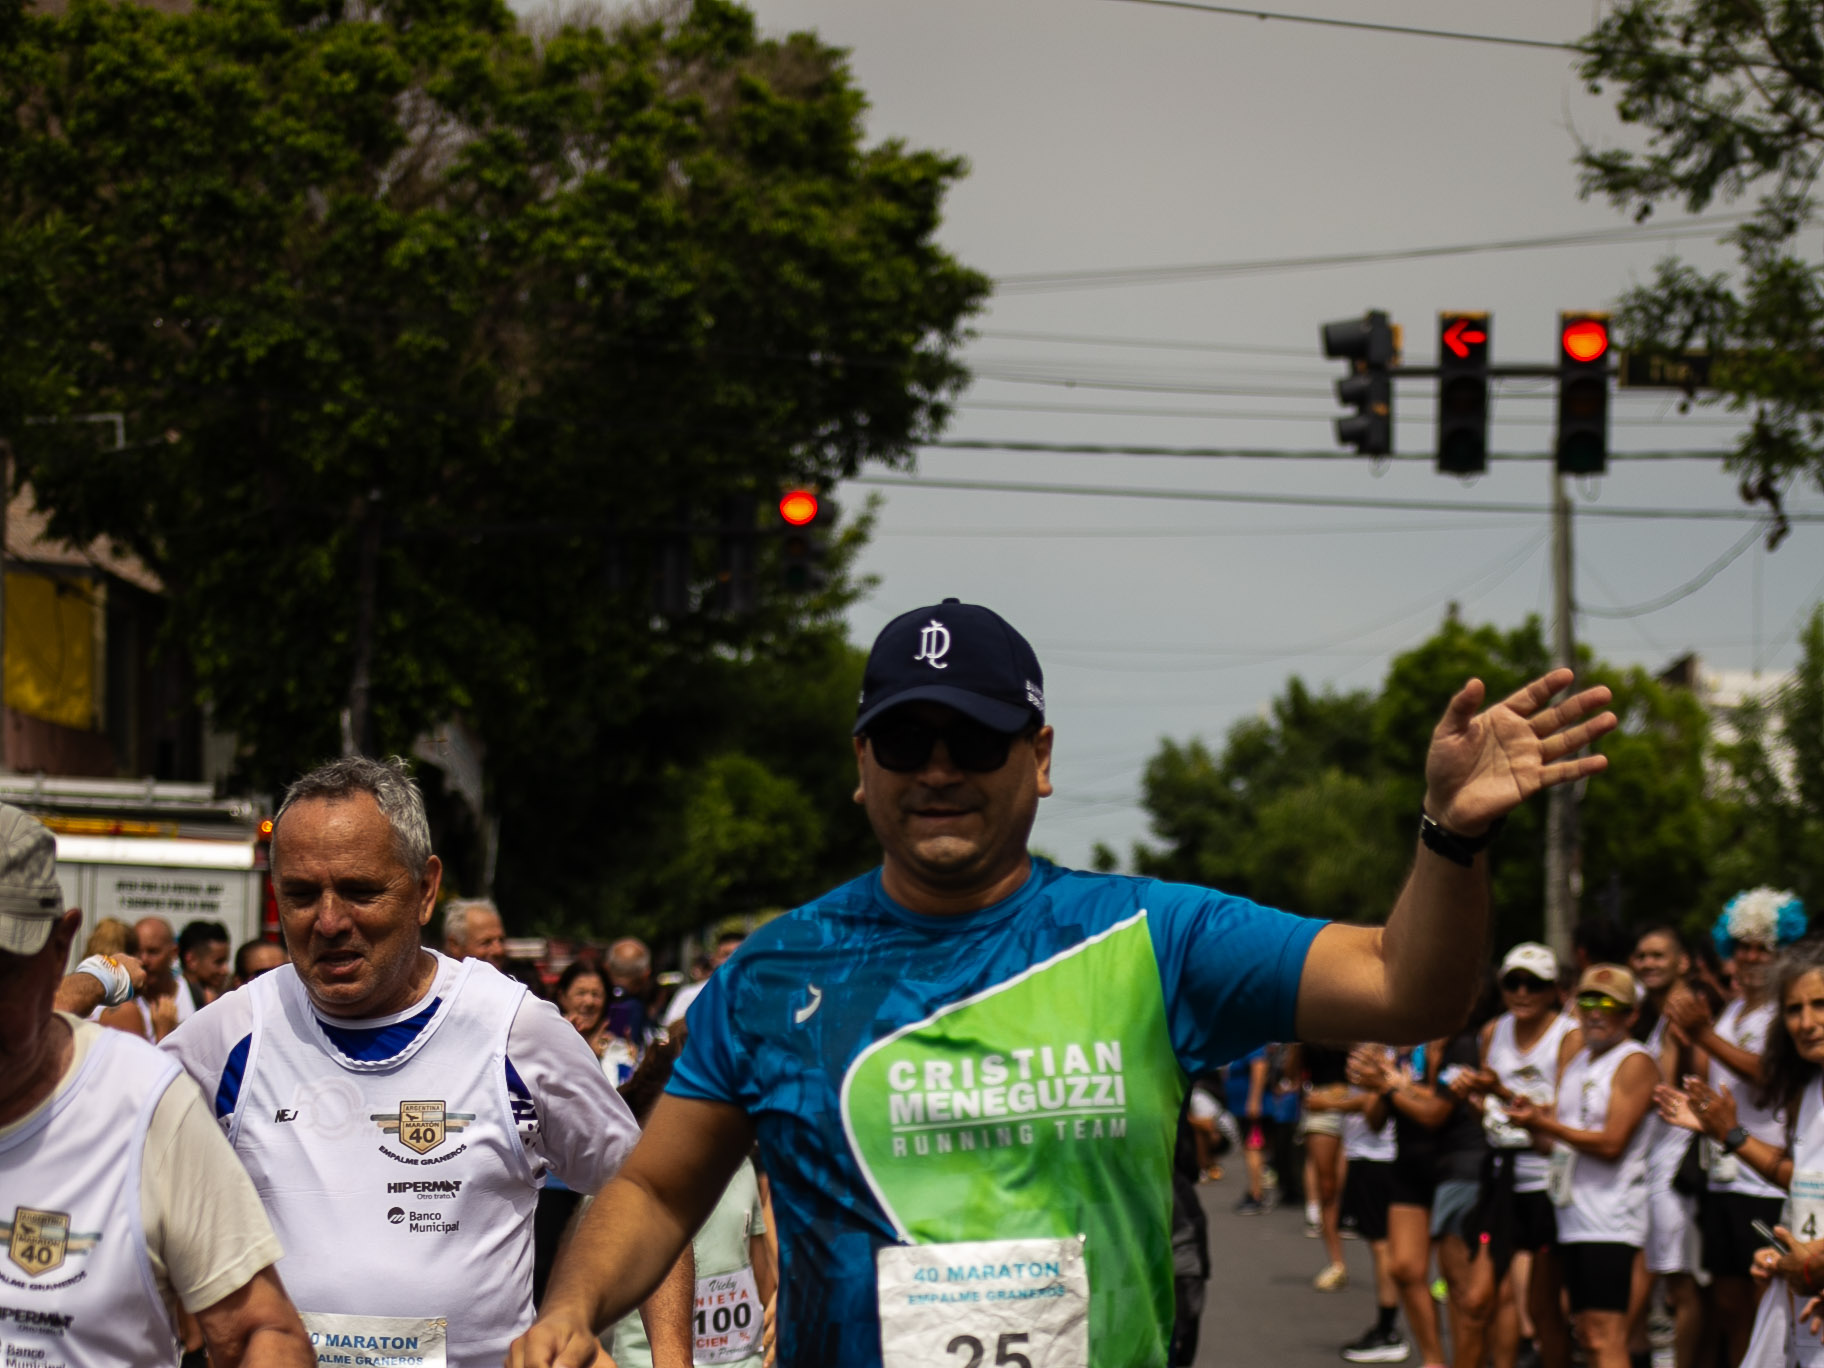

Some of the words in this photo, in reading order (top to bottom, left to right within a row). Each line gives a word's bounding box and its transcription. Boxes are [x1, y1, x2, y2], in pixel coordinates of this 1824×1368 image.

[888, 1041, 1123, 1091] CRISTIAN
[889, 1075, 1126, 1125] MENEGUZZI
[409, 1128, 436, 1144] 40
[893, 1125, 1034, 1157] RUNNING
[1055, 1118, 1127, 1141] TEAM
[378, 1145, 419, 1165] EMPALME
[420, 1143, 468, 1165] GRANEROS
[409, 1211, 442, 1222] Banco
[409, 1220, 460, 1235] Municipal
[20, 1245, 52, 1266] 40
[914, 1266, 939, 1283] 40
[946, 1261, 1060, 1282] MARATON
[708, 1276, 738, 1292] Vicky
[695, 1288, 749, 1308] NIETA
[908, 1290, 980, 1305] EMPALME
[986, 1284, 1066, 1302] GRANEROS
[694, 1302, 752, 1336] 100
[7, 1343, 45, 1360] Banco
[325, 1333, 419, 1350] MARATON
[696, 1335, 728, 1349] CIEN
[318, 1353, 351, 1365] ALME
[355, 1355, 424, 1367] GRANEROS
